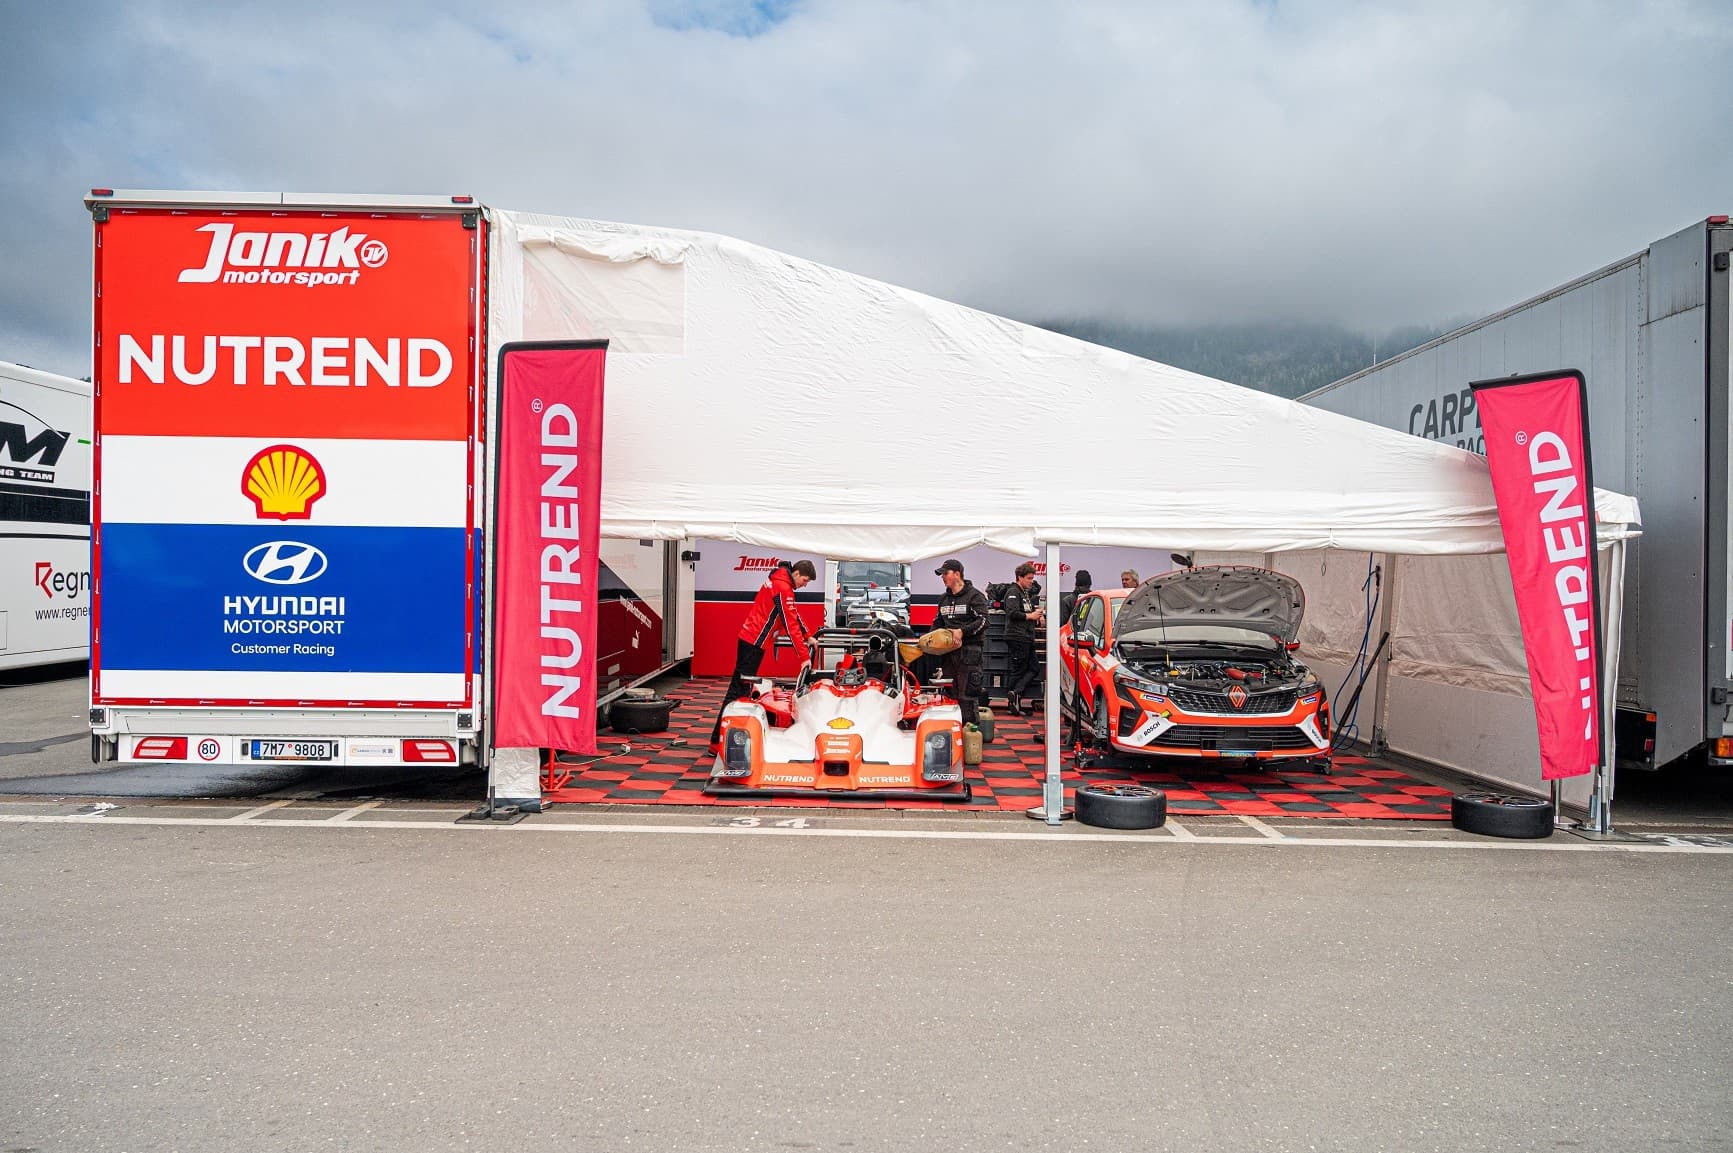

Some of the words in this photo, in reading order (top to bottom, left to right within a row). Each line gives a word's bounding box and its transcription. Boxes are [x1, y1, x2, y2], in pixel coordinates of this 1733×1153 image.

[223, 269, 361, 288] motorsport
[118, 334, 453, 388] NUTREND
[1409, 388, 1481, 439] CARP
[19, 470, 53, 481] TEAM
[541, 403, 582, 719] NUTREND
[1529, 431, 1593, 740] TREND
[224, 596, 345, 616] HYUNDAI
[224, 619, 345, 634] MOTORSPORT
[231, 643, 289, 655] Customer
[293, 643, 335, 657] Racing
[201, 743, 217, 755] 80
[262, 742, 285, 756] 7M7
[294, 744, 325, 757] 9808
[763, 774, 815, 783] NUTREND
[858, 776, 911, 784] NUTREND
